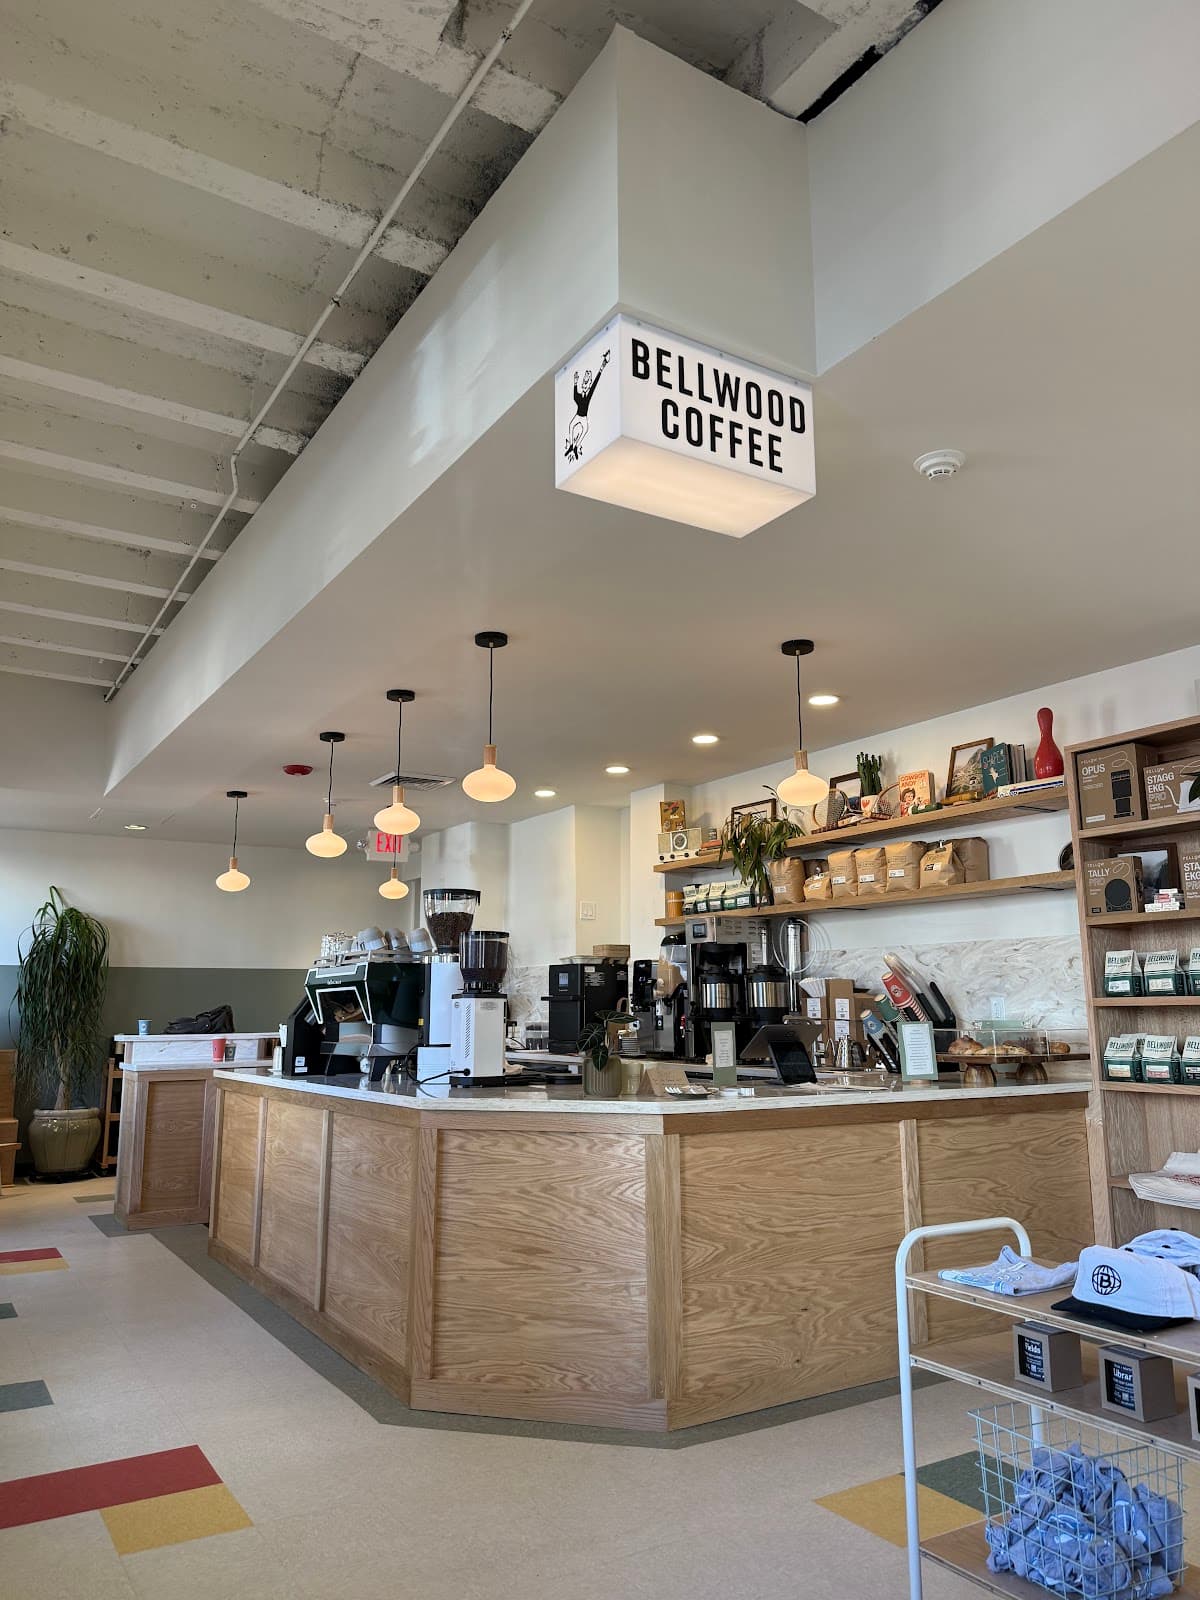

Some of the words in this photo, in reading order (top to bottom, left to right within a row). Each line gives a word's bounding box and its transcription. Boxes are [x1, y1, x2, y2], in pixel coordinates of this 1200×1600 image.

[632, 338, 806, 434] BELLWOOD
[661, 399, 783, 473] COFFEE
[1082, 764, 1105, 776] OPUS
[1147, 772, 1175, 785] STAGG
[1148, 783, 1165, 794] EKG
[1149, 791, 1167, 803] PRO
[376, 832, 404, 854] EXIT
[1087, 867, 1110, 878] TALLY
